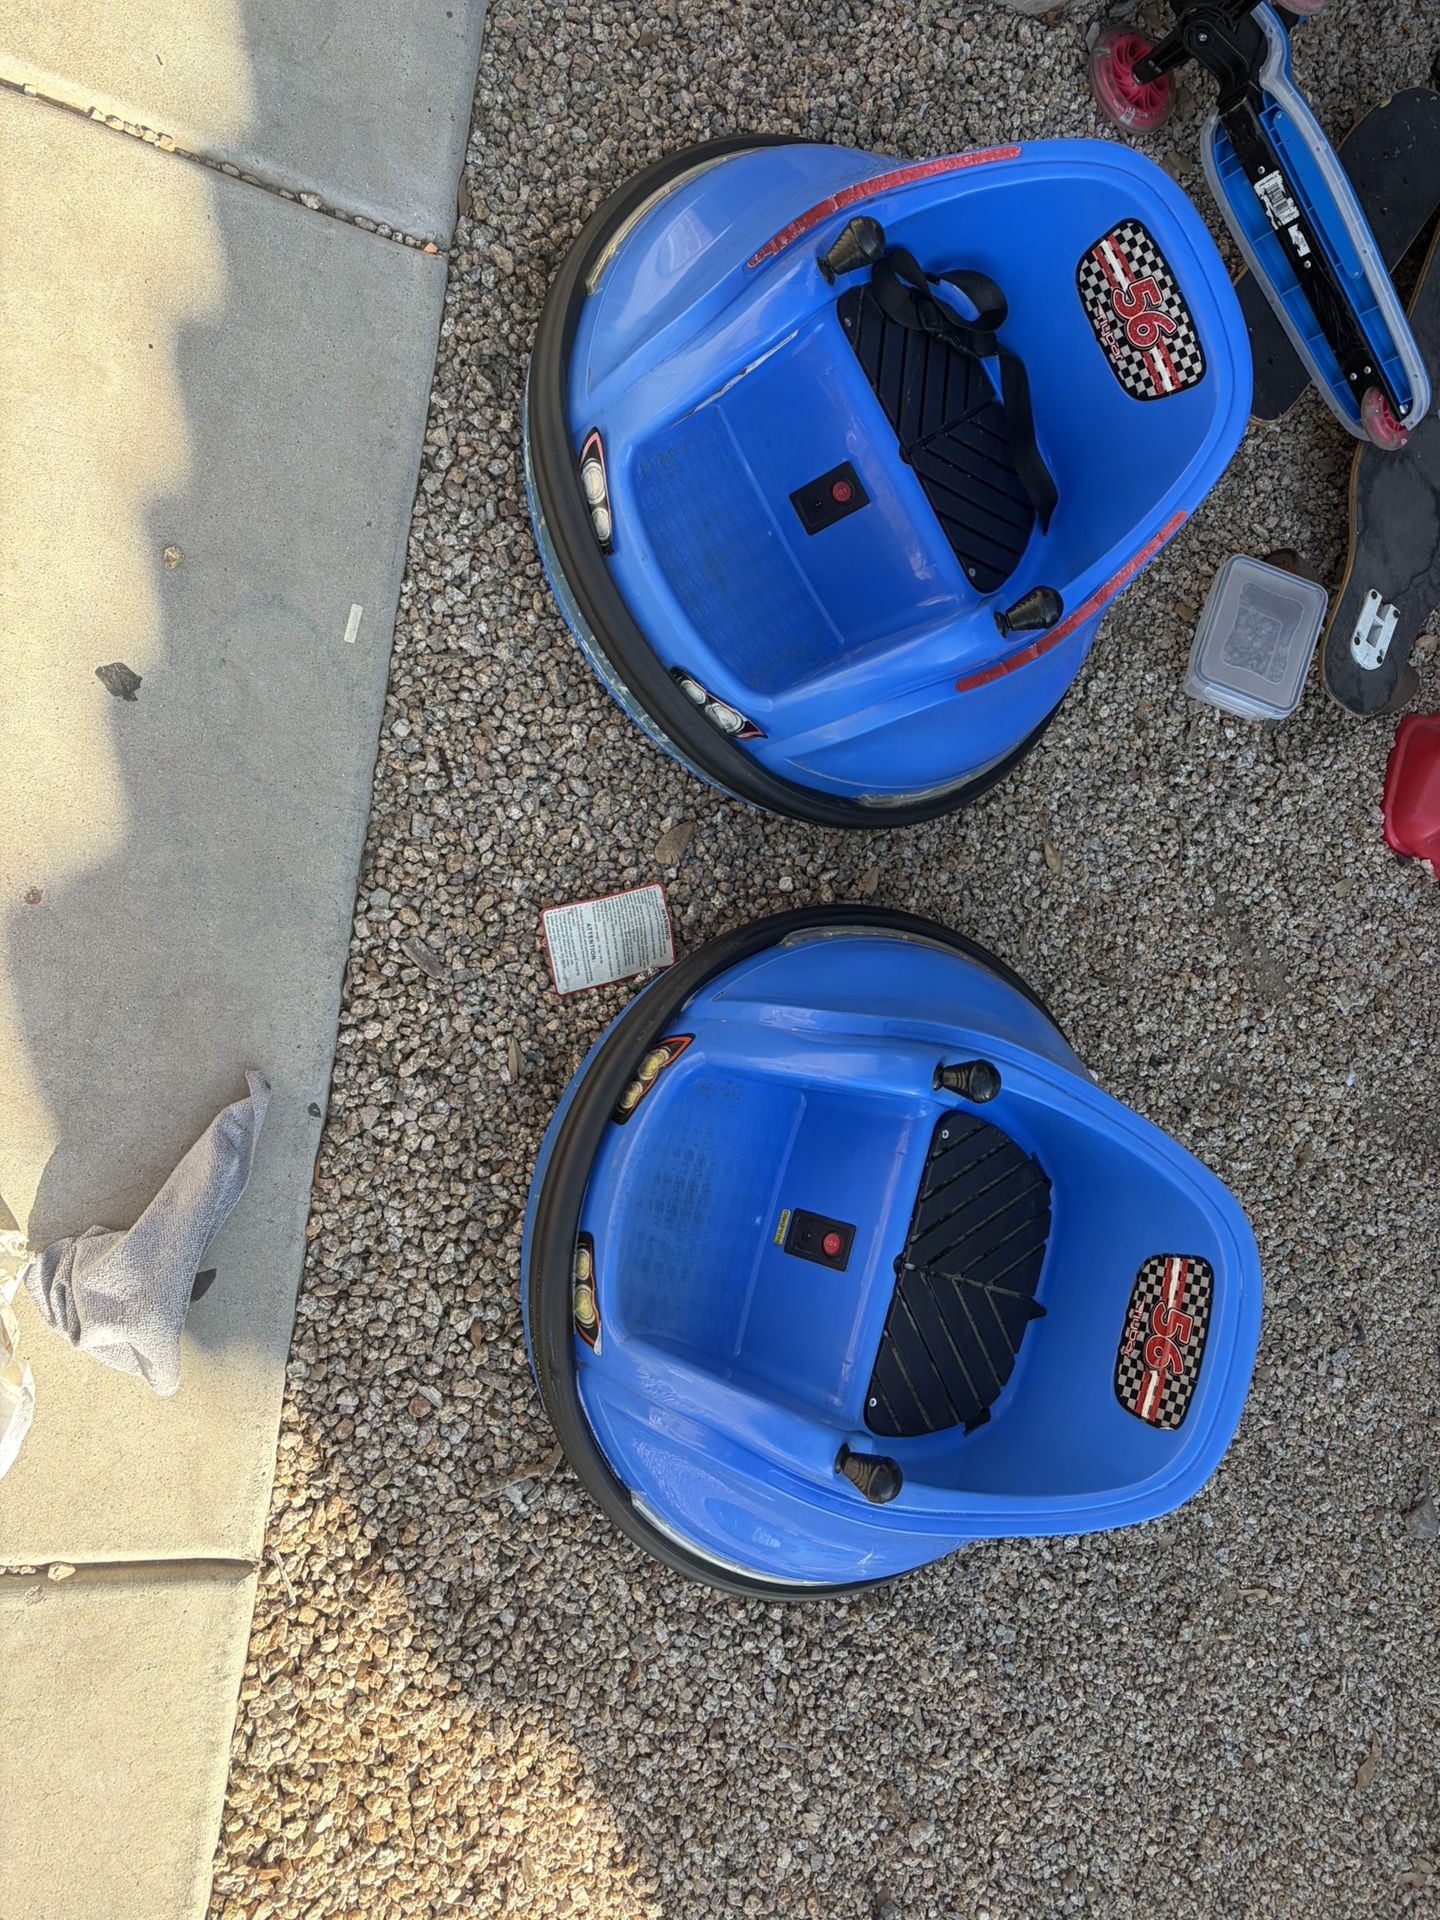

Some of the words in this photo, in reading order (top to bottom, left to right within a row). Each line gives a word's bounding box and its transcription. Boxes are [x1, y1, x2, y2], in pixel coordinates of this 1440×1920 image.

[1096, 299, 1124, 361] flybar
[1112, 275, 1178, 348] 56
[1123, 1296, 1148, 1358] flybar
[1145, 1300, 1194, 1376] 56
